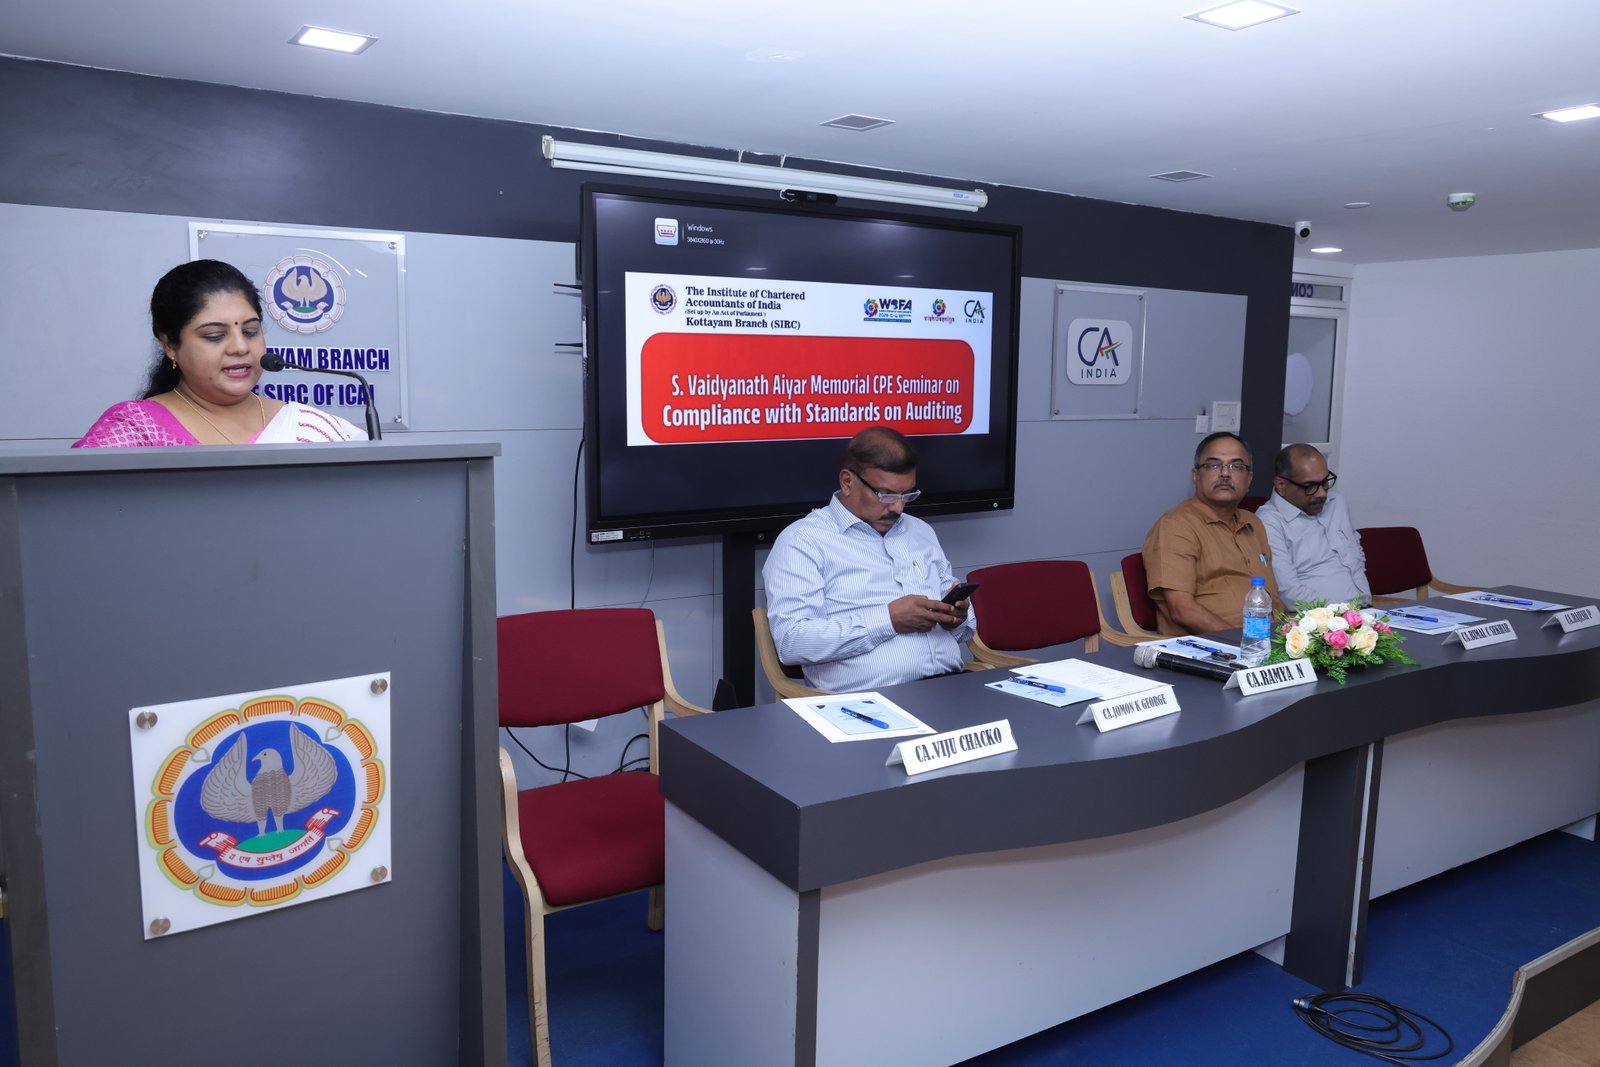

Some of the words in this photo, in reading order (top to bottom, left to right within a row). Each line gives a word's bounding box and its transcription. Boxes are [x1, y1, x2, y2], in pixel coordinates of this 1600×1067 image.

[687, 223, 713, 233] Windows
[685, 286, 705, 296] The
[707, 287, 748, 298] Institute
[750, 289, 759, 299] of
[761, 290, 806, 300] Chartered
[685, 298, 745, 309] Accountants
[747, 300, 757, 310] of
[758, 300, 782, 310] India
[964, 300, 986, 318] CA
[686, 317, 733, 328] Kottayam
[735, 318, 768, 329] Branch
[770, 319, 801, 330] (SIRC)
[1077, 327, 1123, 367] CA
[318, 348, 389, 370] BRANCH
[1081, 368, 1117, 379] INDIA
[264, 384, 308, 406] SIRC
[313, 384, 334, 406] OF
[339, 384, 374, 406] ICAI
[671, 374, 684, 396] S.
[688, 374, 769, 400] Vaidyanath
[772, 374, 807, 400] Aiyar
[810, 374, 869, 395] Memorial
[873, 375, 893, 394] CPE
[896, 374, 943, 395] Seminar
[945, 379, 960, 394] on
[663, 404, 760, 430] Compliance
[765, 402, 801, 424] with
[806, 401, 880, 423] Standards
[884, 405, 902, 421] on
[905, 400, 962, 425] Auditing
[1246, 665, 1294, 688] CA.RAMYA
[1295, 663, 1305, 679] N
[1102, 704, 1135, 720] CA.JOMON
[1136, 702, 1141, 712] K
[1141, 694, 1167, 709] GEORGE
[915, 738, 957, 762] CA.VIJU
[959, 727, 1002, 752] CHACKO
